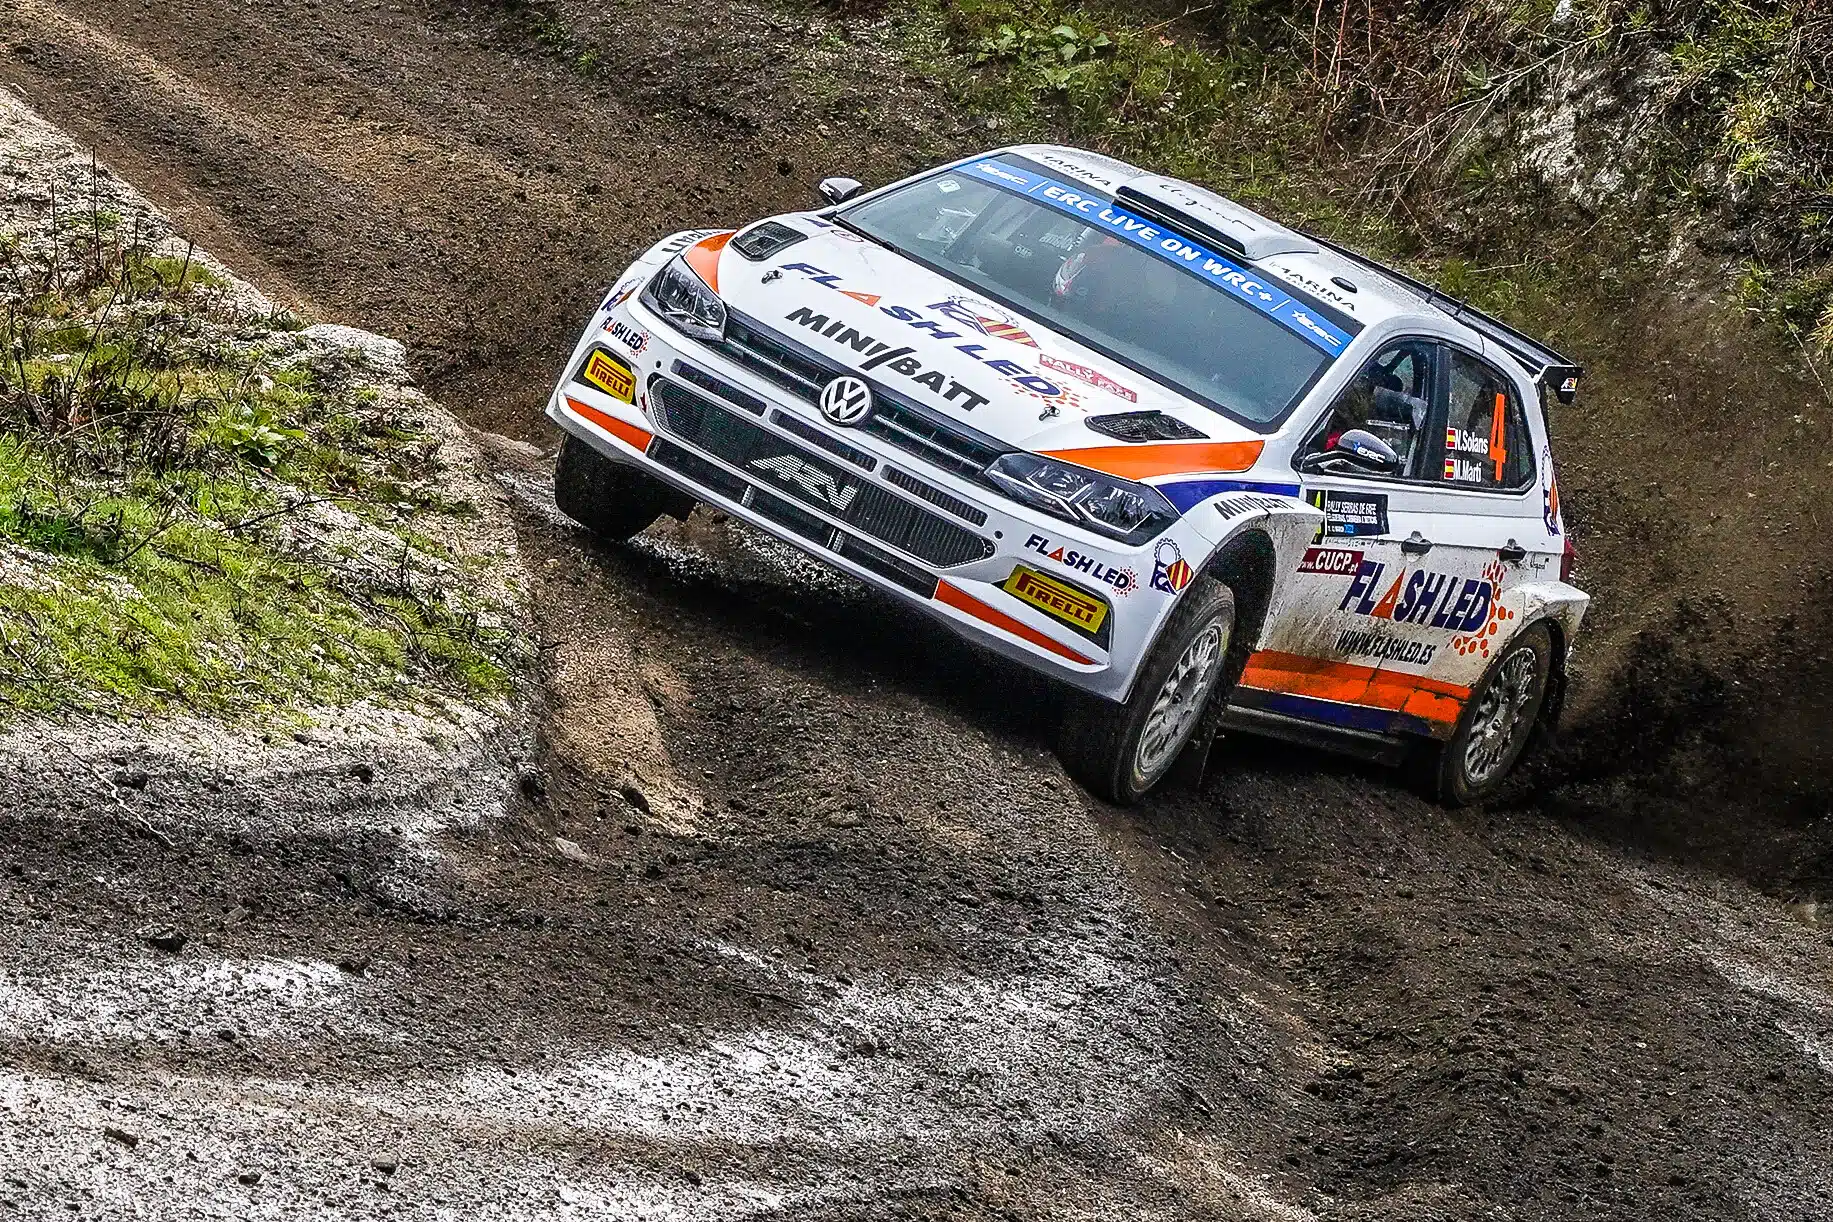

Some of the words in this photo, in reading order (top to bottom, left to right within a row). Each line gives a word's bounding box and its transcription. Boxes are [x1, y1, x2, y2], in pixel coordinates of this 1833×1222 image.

[1043, 186, 1098, 213] ERC
[1099, 209, 1160, 240] LIVE
[1161, 239, 1201, 260] ON
[1202, 258, 1272, 302] WRC+
[1281, 267, 1355, 311] MARINA
[622, 329, 643, 350] LED
[778, 263, 962, 339] FLASH
[953, 344, 1060, 396] LED
[590, 356, 632, 397] PIRELLI
[1490, 393, 1507, 481] 4
[1024, 534, 1094, 572] FLASH
[1091, 563, 1130, 589] LED
[1015, 572, 1098, 623] PIRELLI
